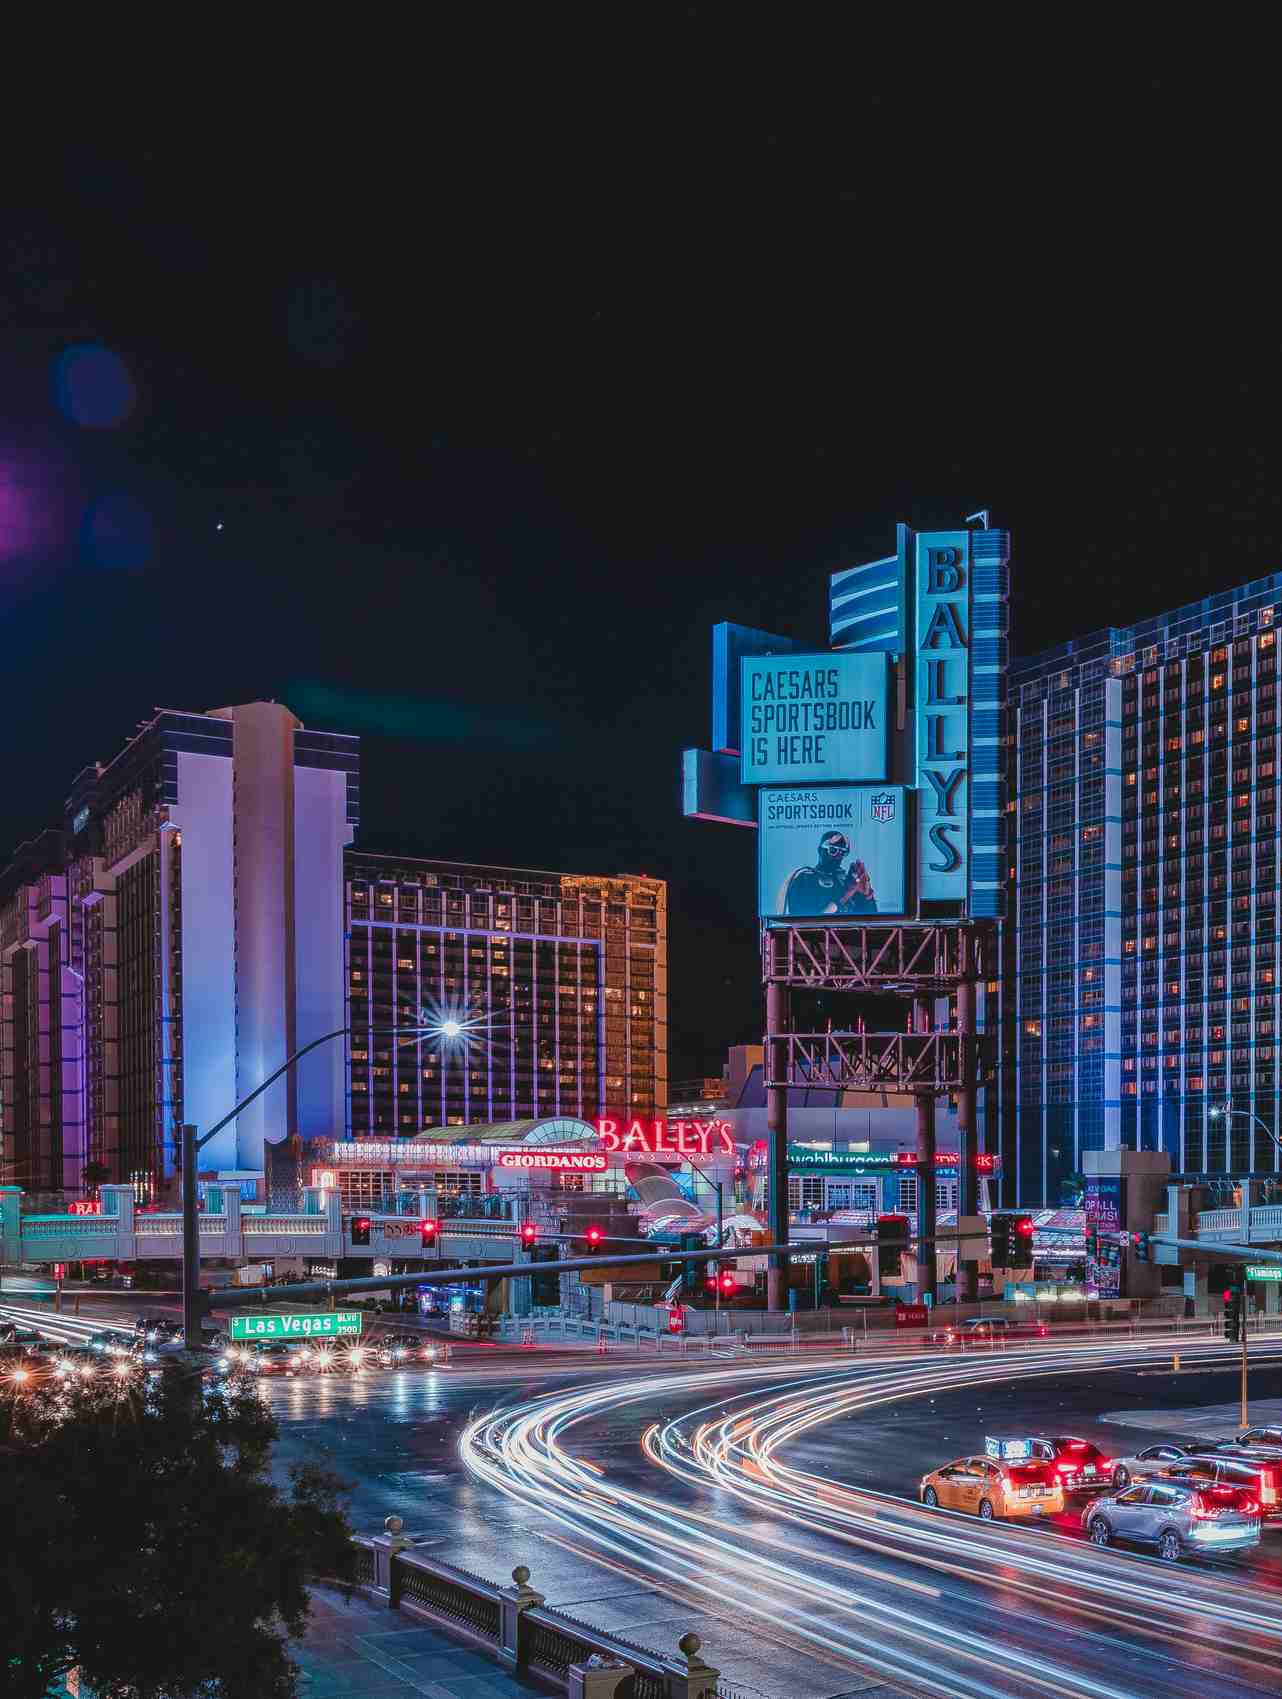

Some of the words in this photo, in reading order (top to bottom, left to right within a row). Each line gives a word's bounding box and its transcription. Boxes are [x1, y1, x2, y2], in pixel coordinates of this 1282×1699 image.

[751, 669, 838, 701] CAESARS
[751, 701, 876, 734] SPORTSBOOK
[924, 546, 967, 873] BALLYS
[752, 737, 768, 766] IS
[777, 735, 825, 765] HERE
[768, 792, 817, 803] CAESARS
[768, 804, 853, 820] SPORTSBOOK
[598, 1119, 735, 1155] BALLY'S
[501, 1154, 606, 1169] GIORDANO'S
[626, 1153, 655, 1161] LAS
[665, 1152, 714, 1161] VEGAS
[245, 1318, 275, 1334] Las
[281, 1316, 331, 1335] Vegas
